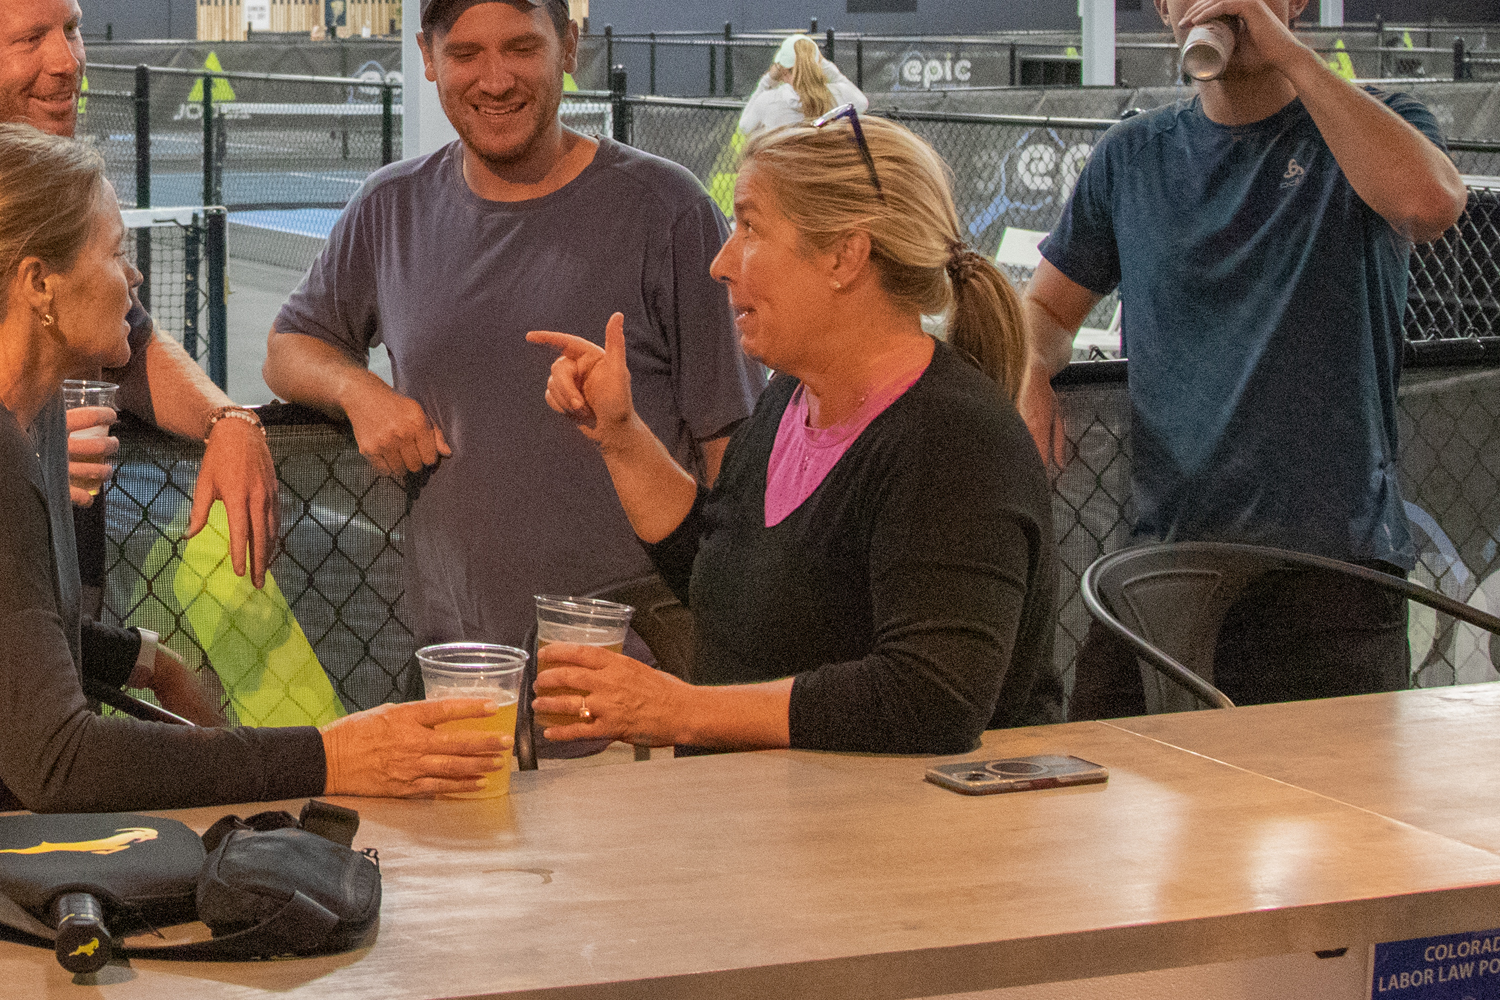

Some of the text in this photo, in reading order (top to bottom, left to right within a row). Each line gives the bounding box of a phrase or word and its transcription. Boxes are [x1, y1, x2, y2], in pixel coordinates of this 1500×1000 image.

[902, 51, 971, 89] epic
[1379, 958, 1500, 992] LABOR LAW PO
